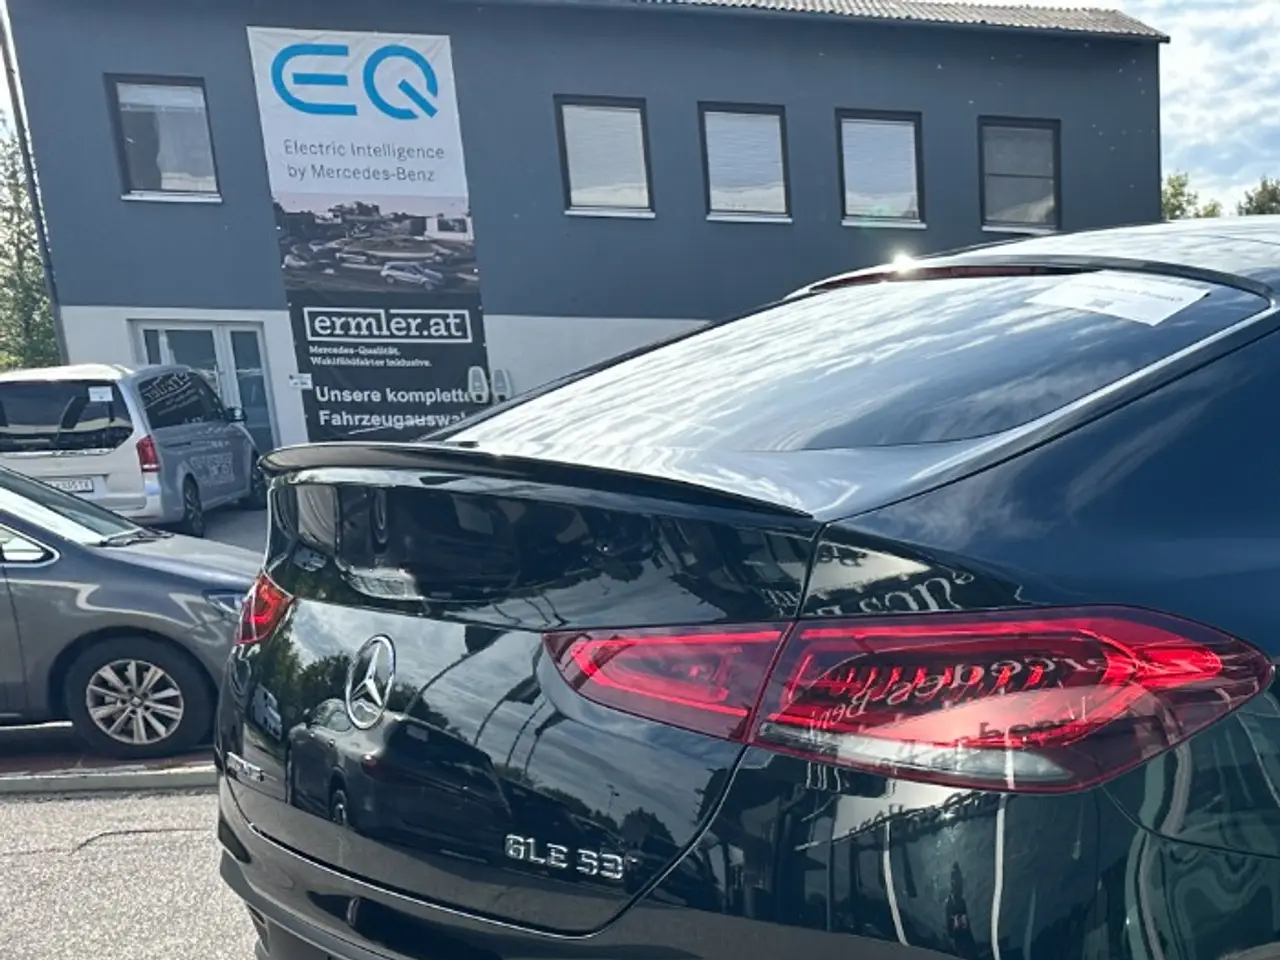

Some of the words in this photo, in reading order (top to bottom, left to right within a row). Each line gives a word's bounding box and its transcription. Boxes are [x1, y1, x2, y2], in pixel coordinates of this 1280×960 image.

[271, 43, 438, 121] EQ
[283, 139, 346, 157] Electric
[351, 142, 445, 161] Intelligence
[287, 164, 307, 182] by
[311, 164, 436, 182] Mercedes-Benz
[313, 309, 463, 337] ermler.at
[315, 386, 382, 402] Unsere
[505, 834, 567, 868] GLE
[577, 849, 623, 879] 53
